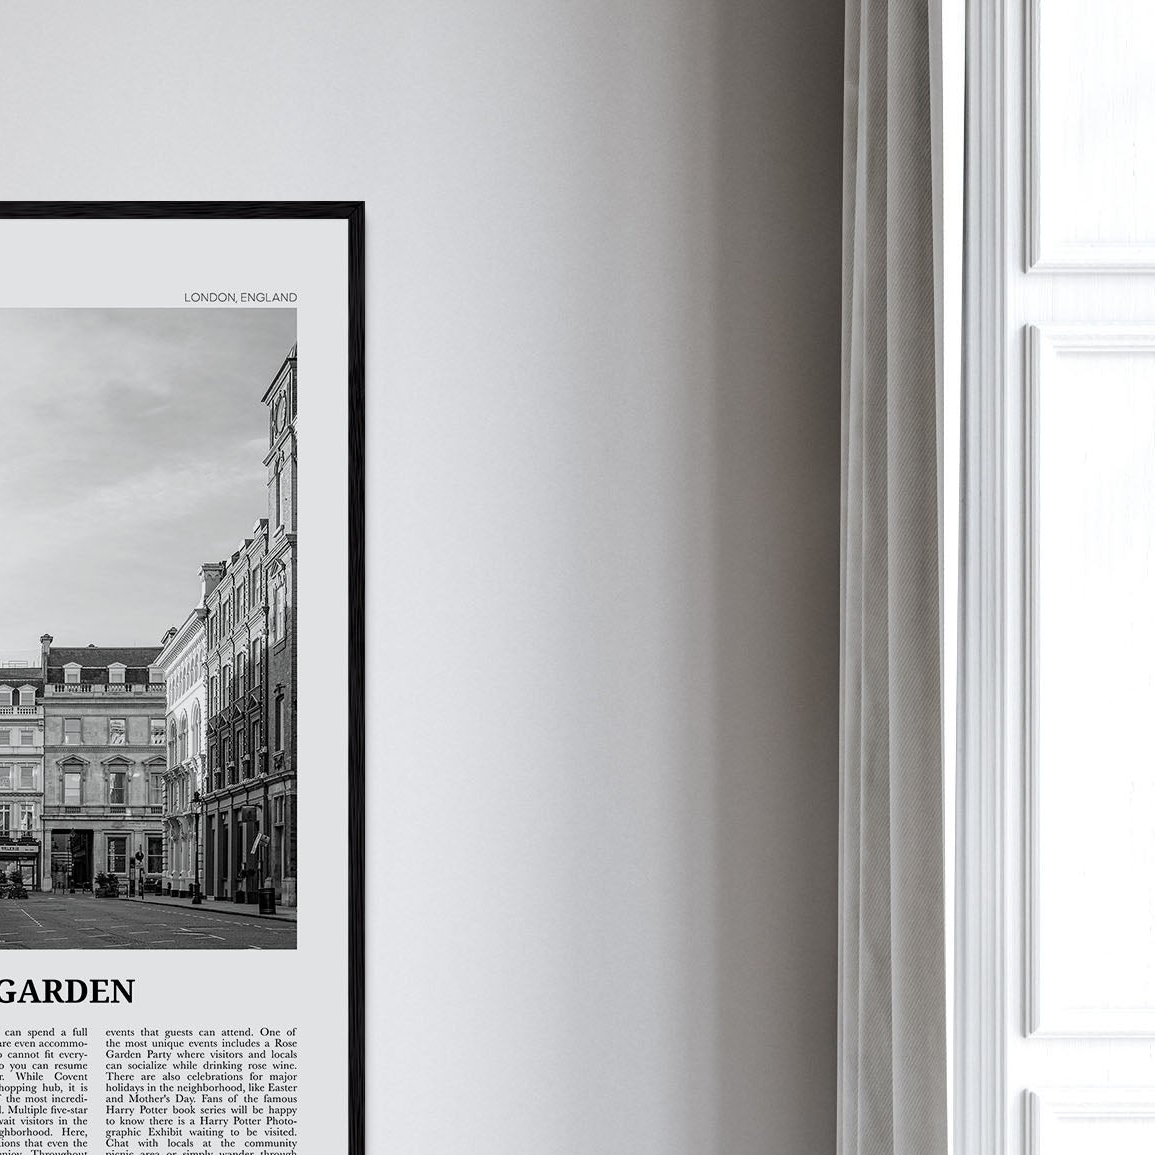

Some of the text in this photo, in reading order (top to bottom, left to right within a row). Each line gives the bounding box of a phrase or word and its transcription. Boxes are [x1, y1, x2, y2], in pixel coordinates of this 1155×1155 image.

[184, 292, 298, 304] LONDON, ENGLAND
[27, 1028, 55, 1038] spend
[73, 1028, 88, 1036] full
[105, 1028, 135, 1036] events
[140, 1028, 159, 1036] that
[165, 1028, 193, 1038] guests
[221, 1028, 253, 1036] attend.
[260, 1028, 281, 1036] One
[286, 1028, 296, 1036] of
[45, 1050, 54, 1058] fit
[59, 1052, 88, 1061] every-
[106, 1050, 297, 1061] Garden Party where visitors and locals
[16, 1072, 43, 1080] While
[54, 1072, 88, 1080] Covent
[106, 1072, 135, 1080] There
[162, 1072, 181, 1080] also
[187, 1072, 243, 1080] celebrations
[250, 1072, 263, 1080] for
[270, 1072, 298, 1083] major
[6, 1094, 21, 1102] the
[52, 1094, 88, 1102] incredi-
[105, 1094, 297, 1105] and Mother's Day. Fans of the famous
[20, 1116, 54, 1125] visitors
[58, 1116, 68, 1125] in
[73, 1116, 88, 1125] the
[106, 1117, 115, 1125] to
[120, 1116, 145, 1125] know
[149, 1116, 173, 1125] there
[178, 1116, 185, 1125] is
[200, 1116, 229, 1127] Harry
[233, 1116, 261, 1125] Potter
[266, 1116, 297, 1125] Photo-
[25, 1139, 43, 1147] that
[73, 1139, 88, 1147] the
[106, 1139, 129, 1147] Chat
[138, 1139, 158, 1147] with
[168, 1139, 194, 1147] locals
[221, 1139, 235, 1147] the
[244, 1139, 297, 1150] community
